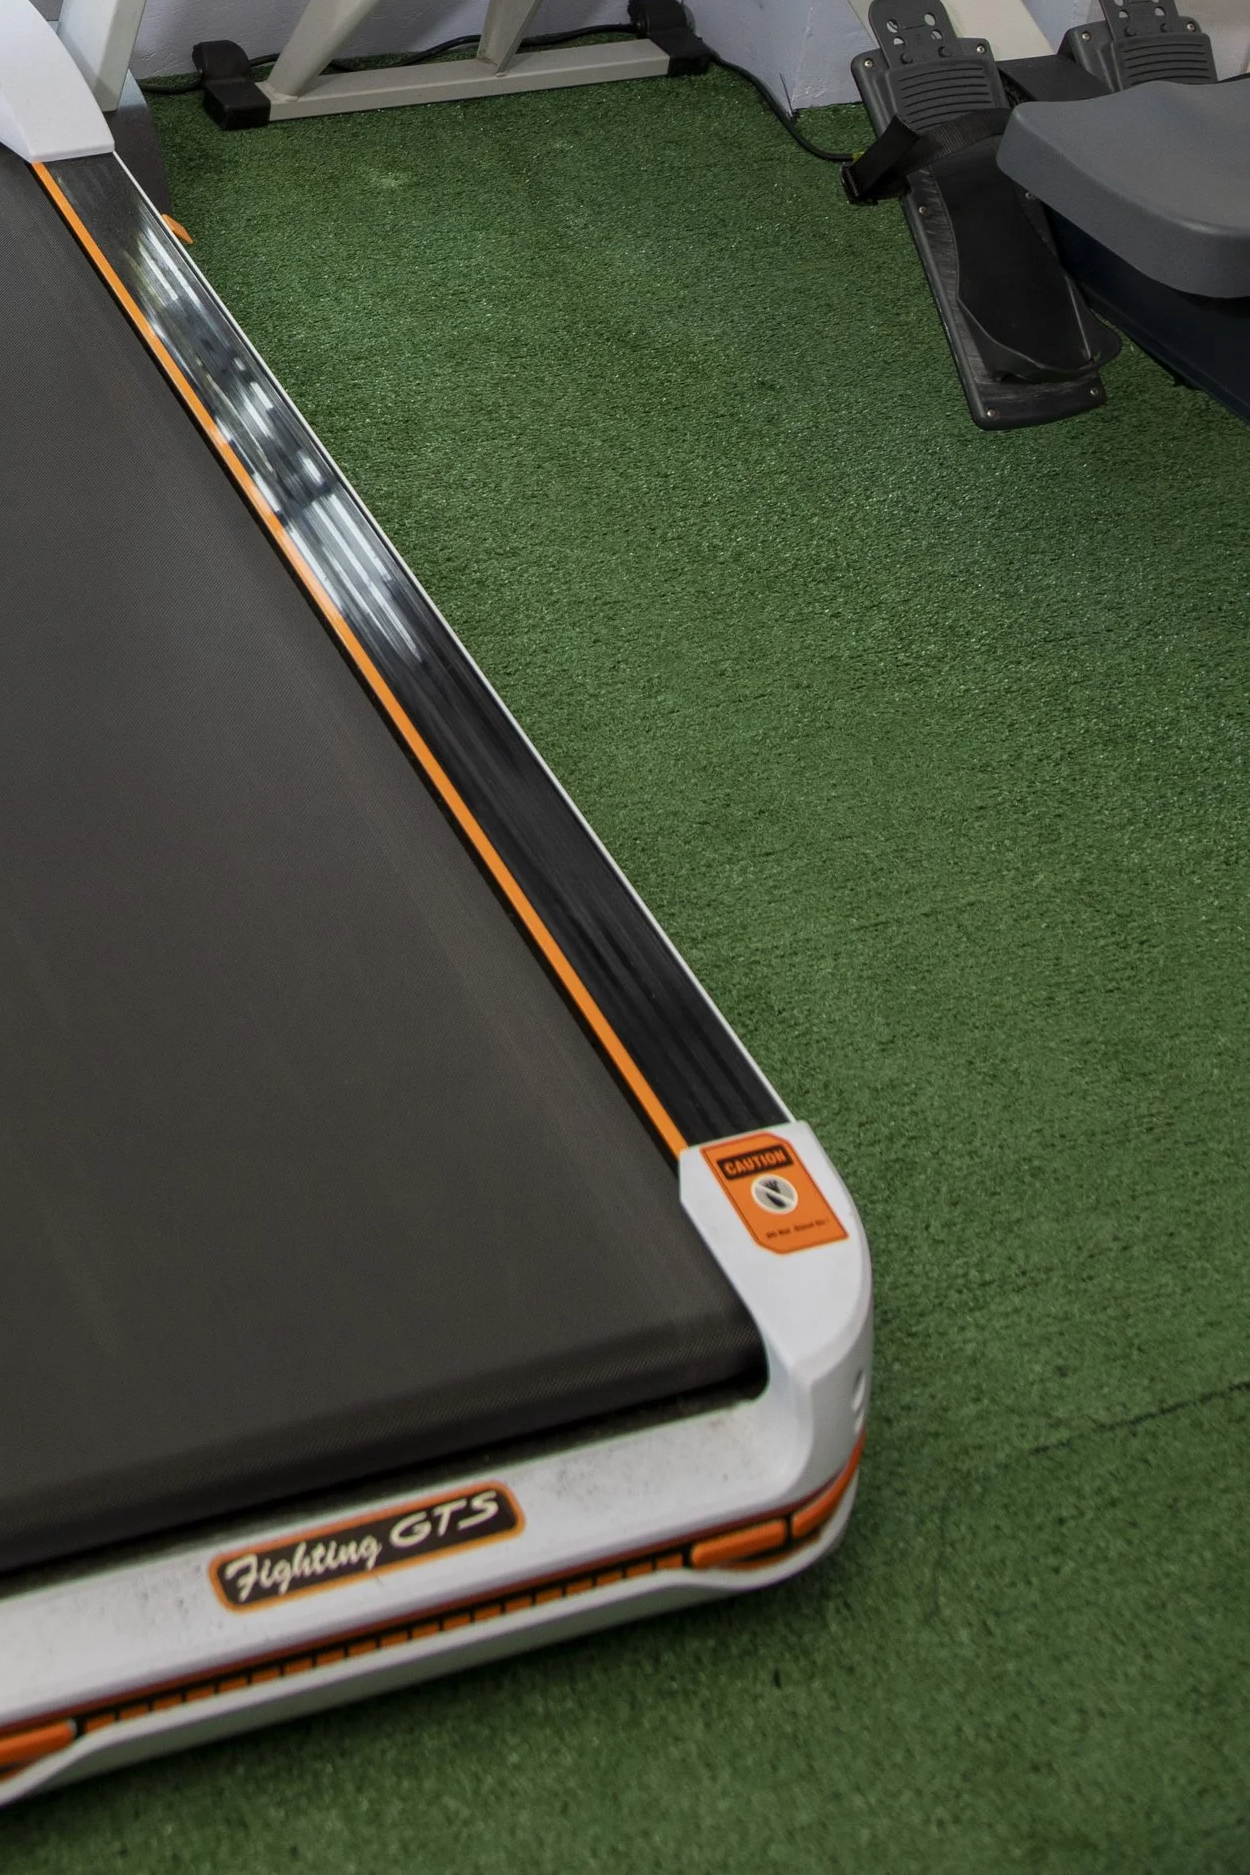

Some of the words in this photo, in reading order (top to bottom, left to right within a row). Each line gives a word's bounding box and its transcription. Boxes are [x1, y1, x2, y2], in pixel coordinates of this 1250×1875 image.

[723, 1149, 787, 1175] CAUTION
[225, 1534, 383, 1602] Fighting
[389, 1489, 499, 1548] GTS
